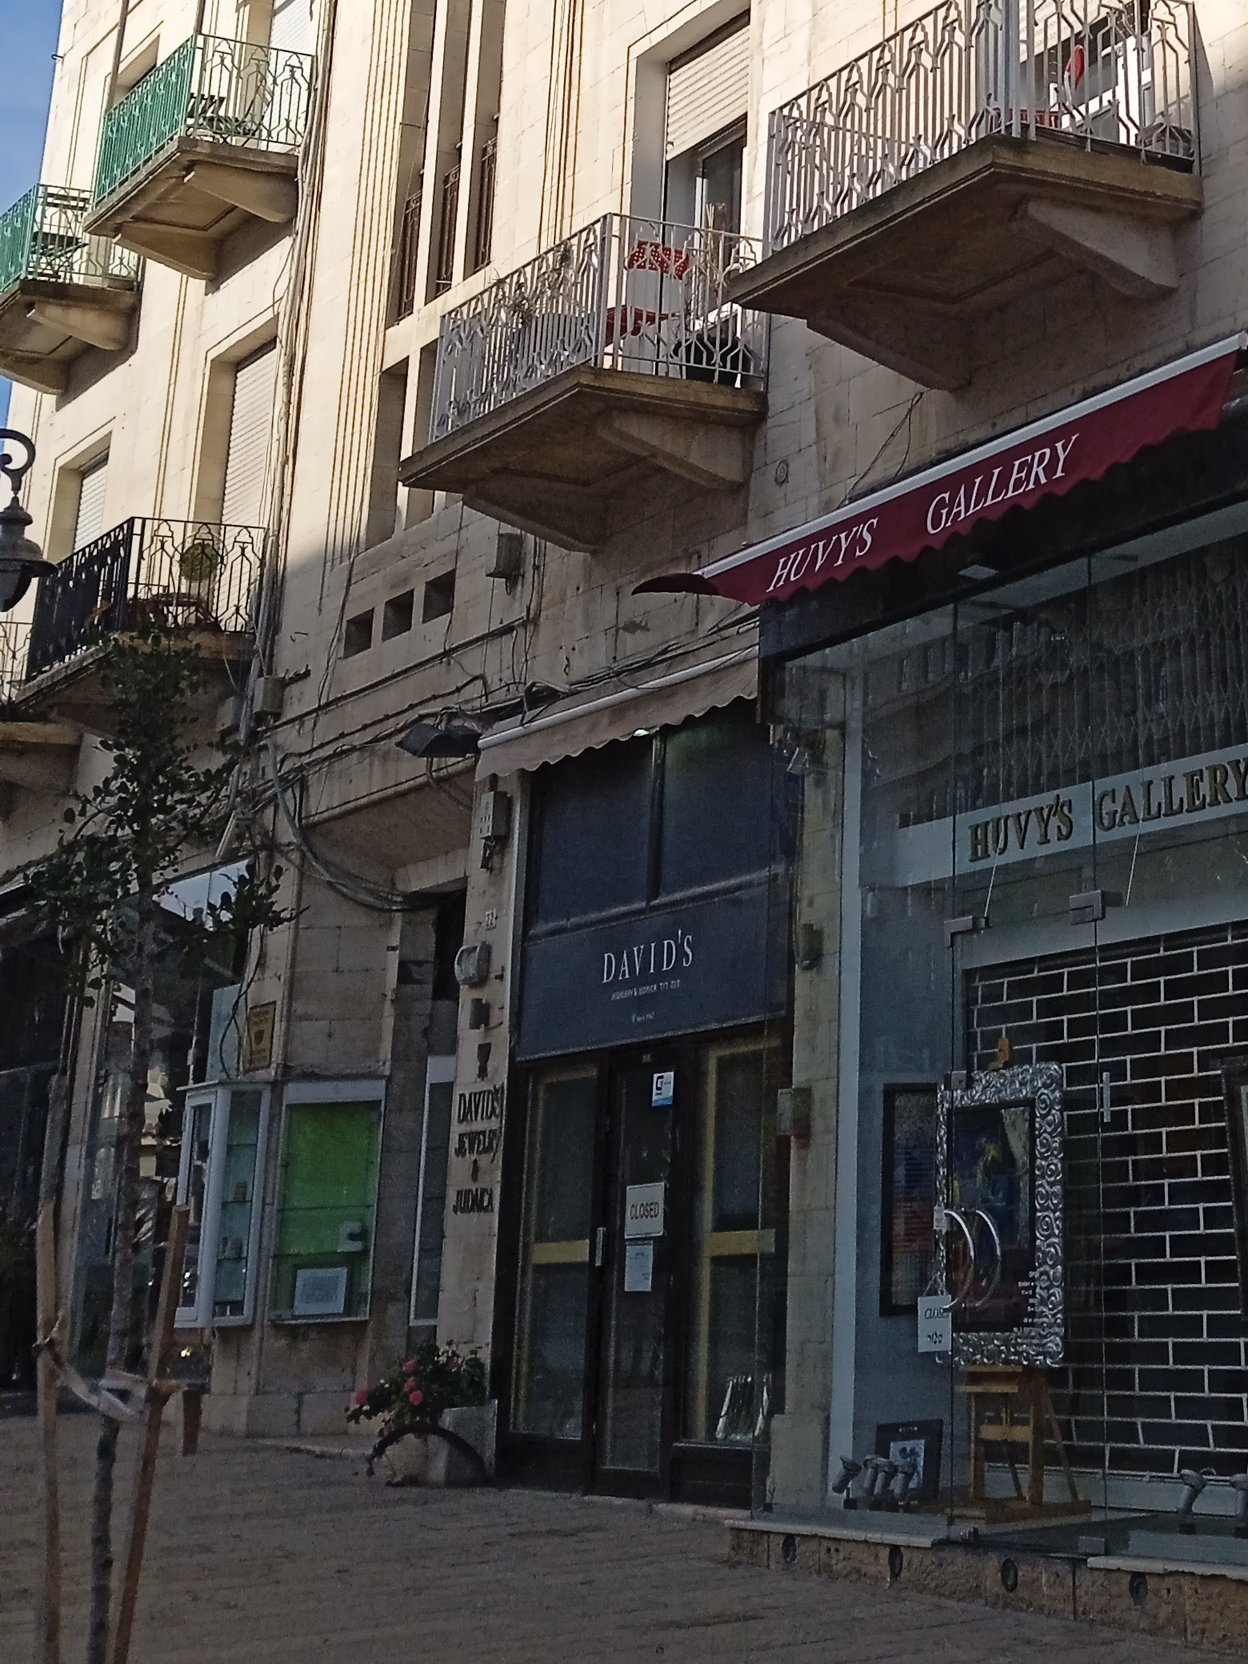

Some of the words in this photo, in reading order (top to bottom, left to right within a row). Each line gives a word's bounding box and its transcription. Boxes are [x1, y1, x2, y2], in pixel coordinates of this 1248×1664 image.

[765, 517, 879, 593] HUVY'S
[925, 433, 1080, 535] GALLERY
[968, 793, 1074, 863] HUVY'S
[602, 929, 694, 984] DAVID'S
[630, 1201, 660, 1220] CLOSED
